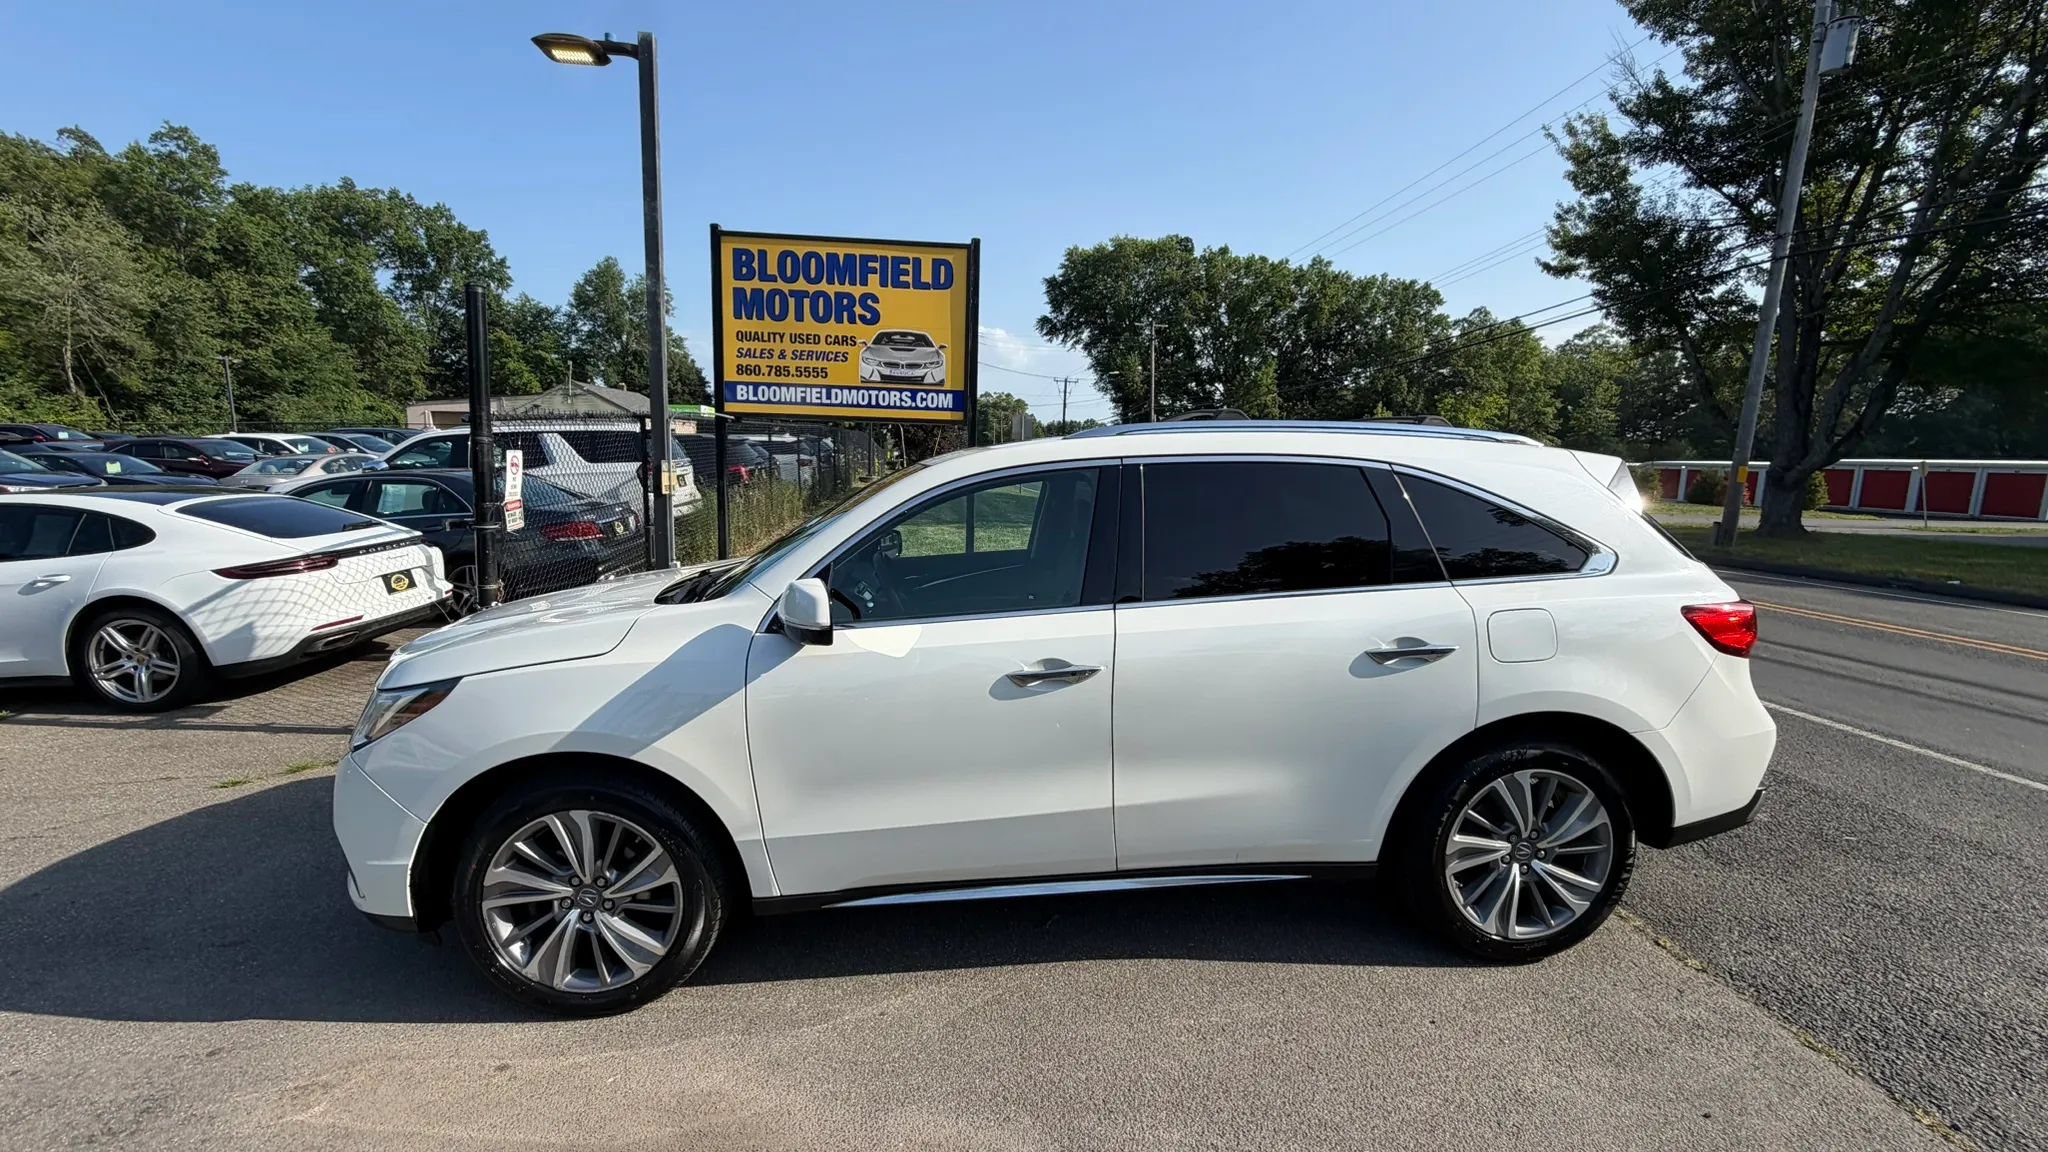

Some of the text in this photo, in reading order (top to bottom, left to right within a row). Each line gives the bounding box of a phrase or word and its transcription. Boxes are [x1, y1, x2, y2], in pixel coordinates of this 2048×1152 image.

[732, 247, 954, 290] BLOOMFIELD
[732, 286, 881, 326] MOTORS
[736, 330, 857, 347] QUALITY USED CARS
[736, 347, 849, 363] SALES & SERVICES
[736, 364, 828, 379] 860.785.5555
[736, 384, 953, 409] BLOOMFIELDMOTORS.COM
[359, 541, 410, 554] PORSCHE
